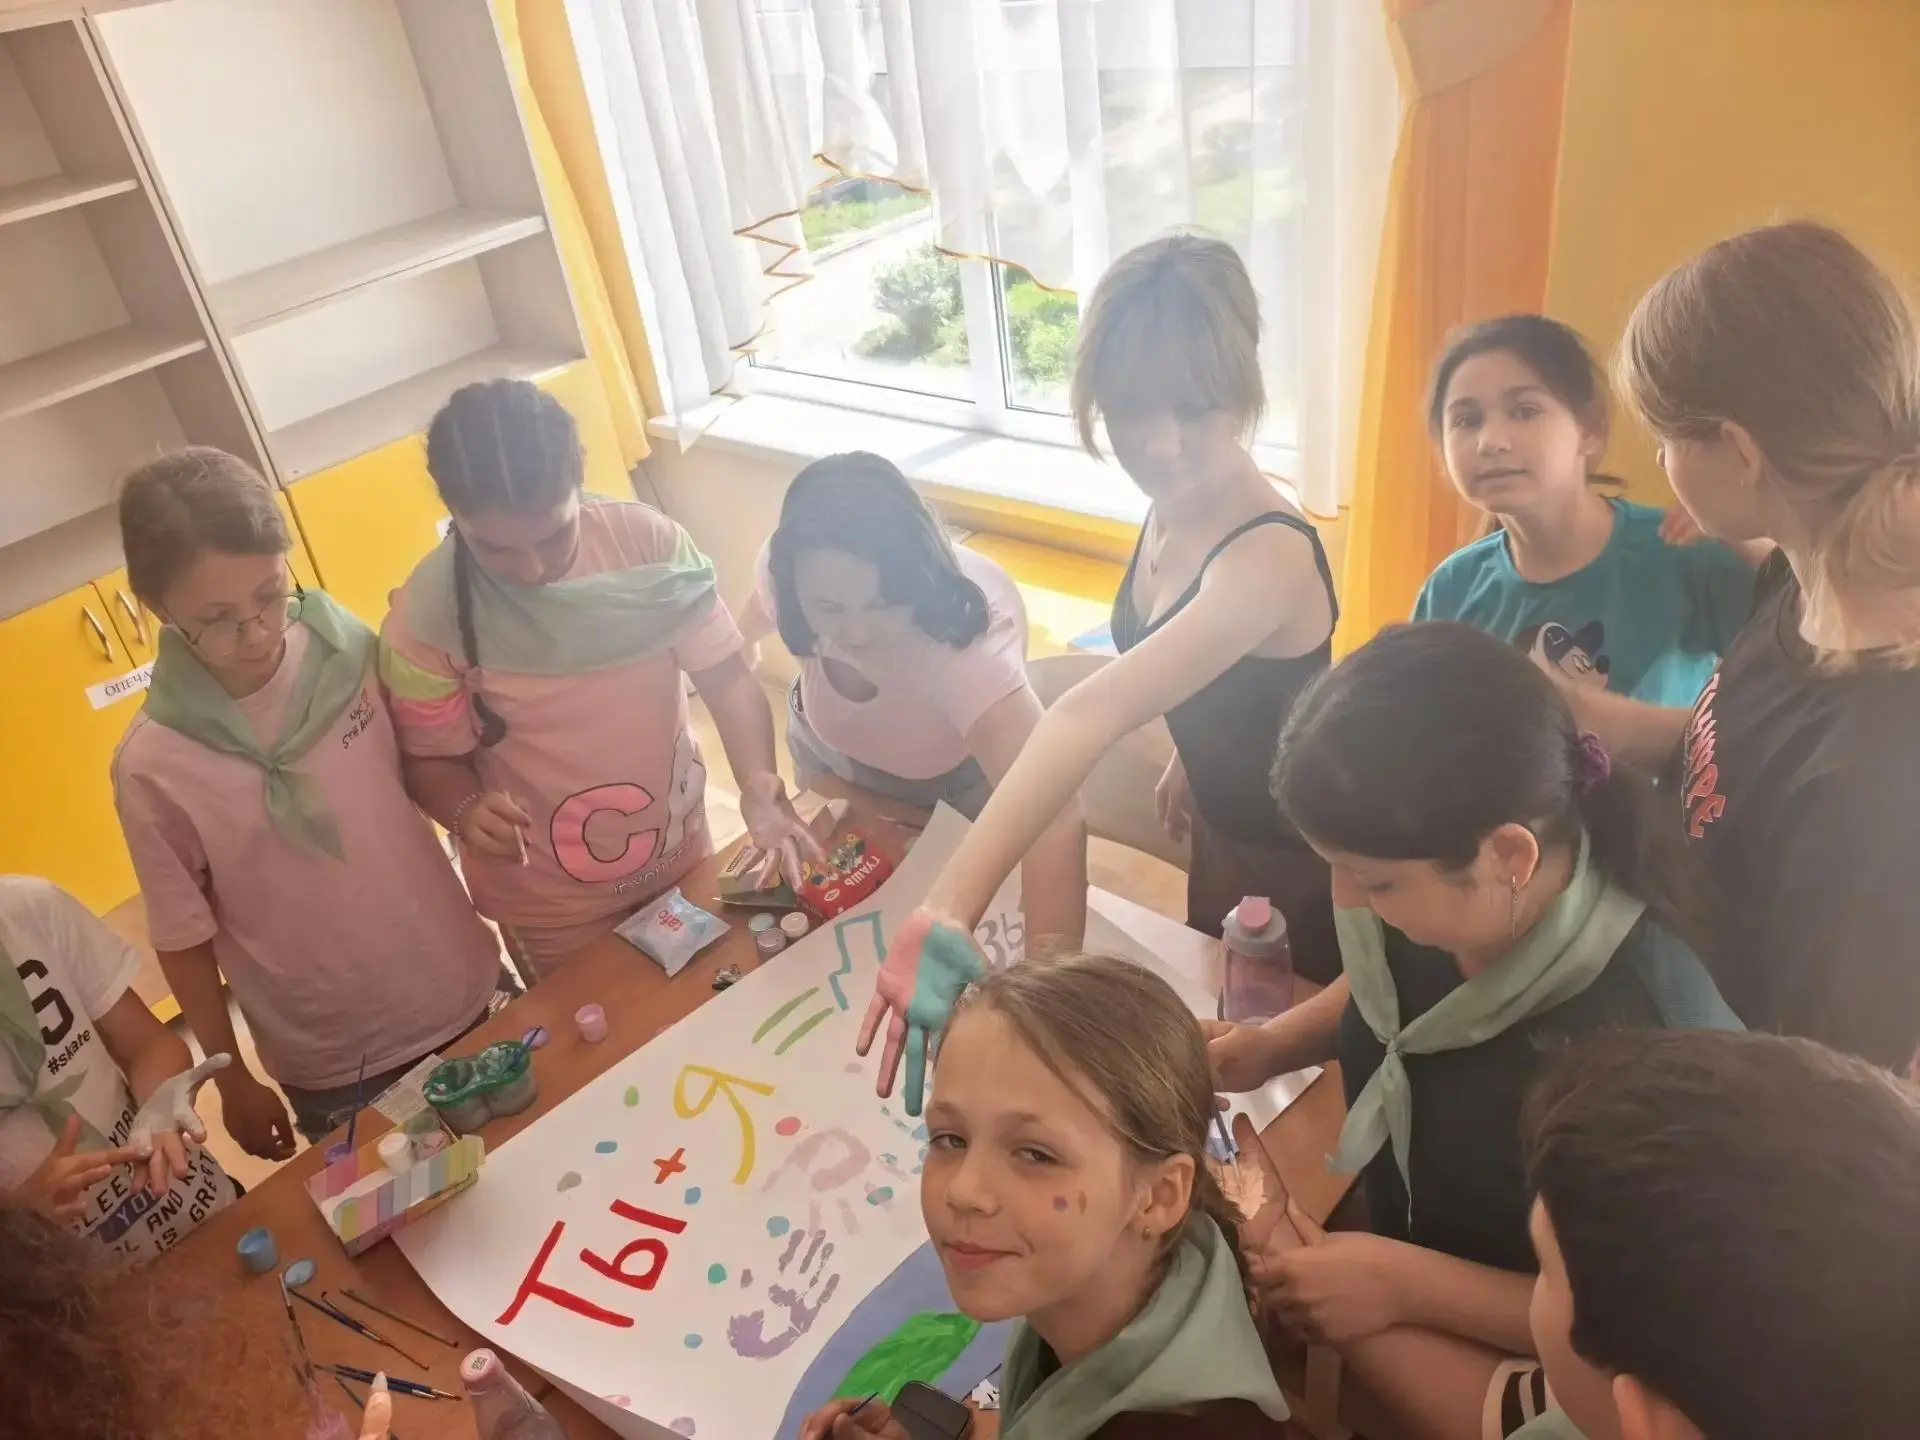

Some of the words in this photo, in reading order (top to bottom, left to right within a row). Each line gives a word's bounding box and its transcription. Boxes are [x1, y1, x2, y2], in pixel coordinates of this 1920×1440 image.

[843, 855, 881, 887] ГУАШЬ
[47, 1029, 92, 1076] #skate
[146, 1188, 184, 1233] AND
[154, 1227, 178, 1252] IS
[189, 1149, 217, 1222] GREAT
